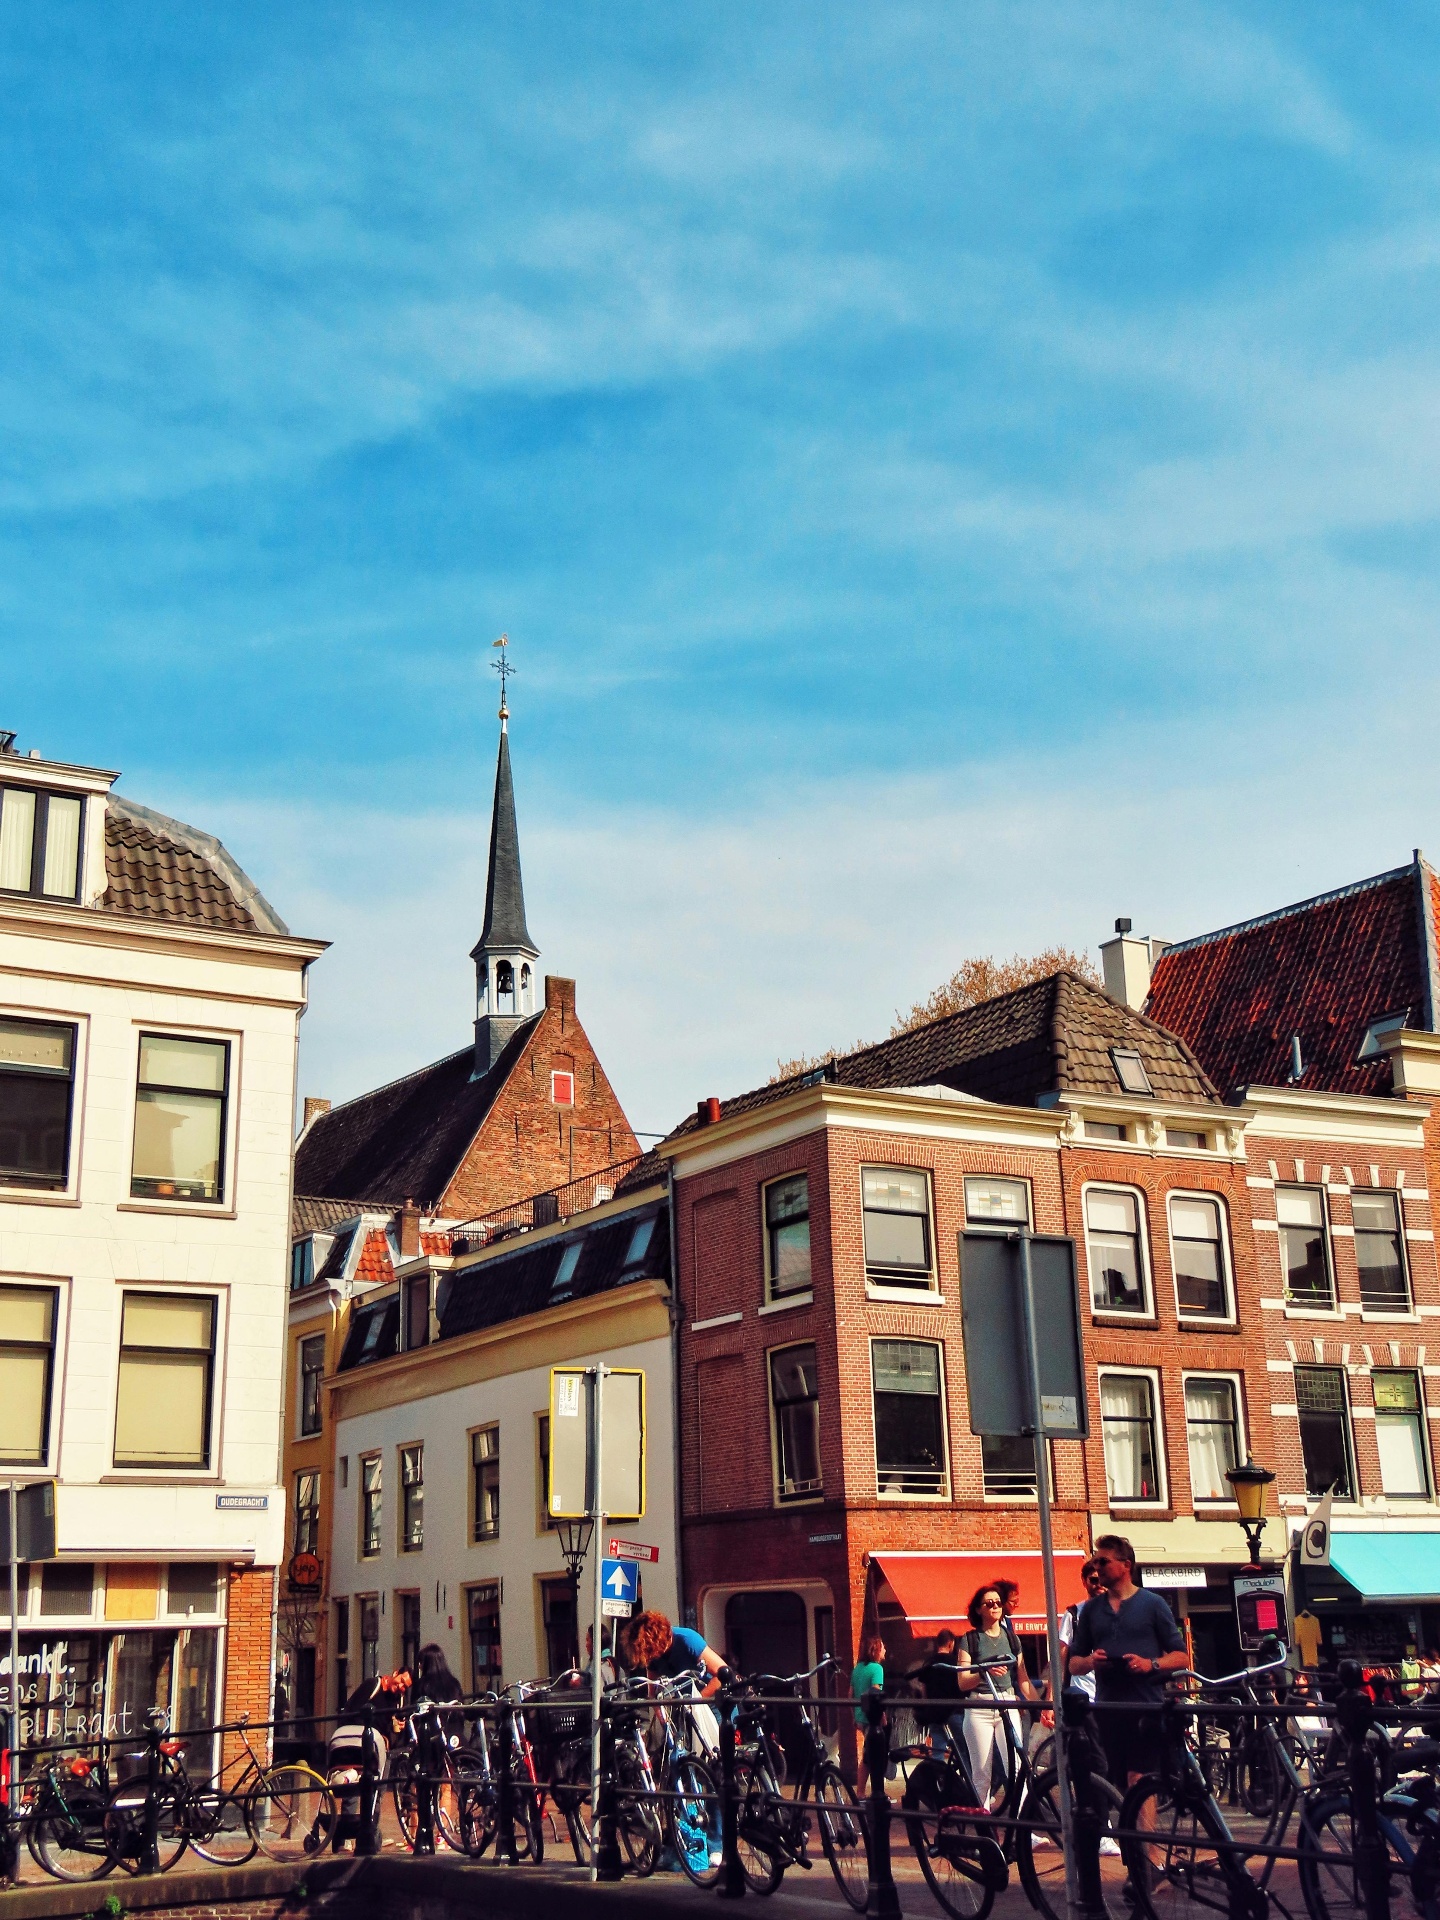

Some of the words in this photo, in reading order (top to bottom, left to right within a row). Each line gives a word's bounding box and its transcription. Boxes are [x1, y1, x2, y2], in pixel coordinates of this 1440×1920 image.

[220, 1498, 265, 1507] OUDEGRACHT
[1145, 1568, 1201, 1578] BLACKBIRD
[1014, 1623, 1023, 1631] EN
